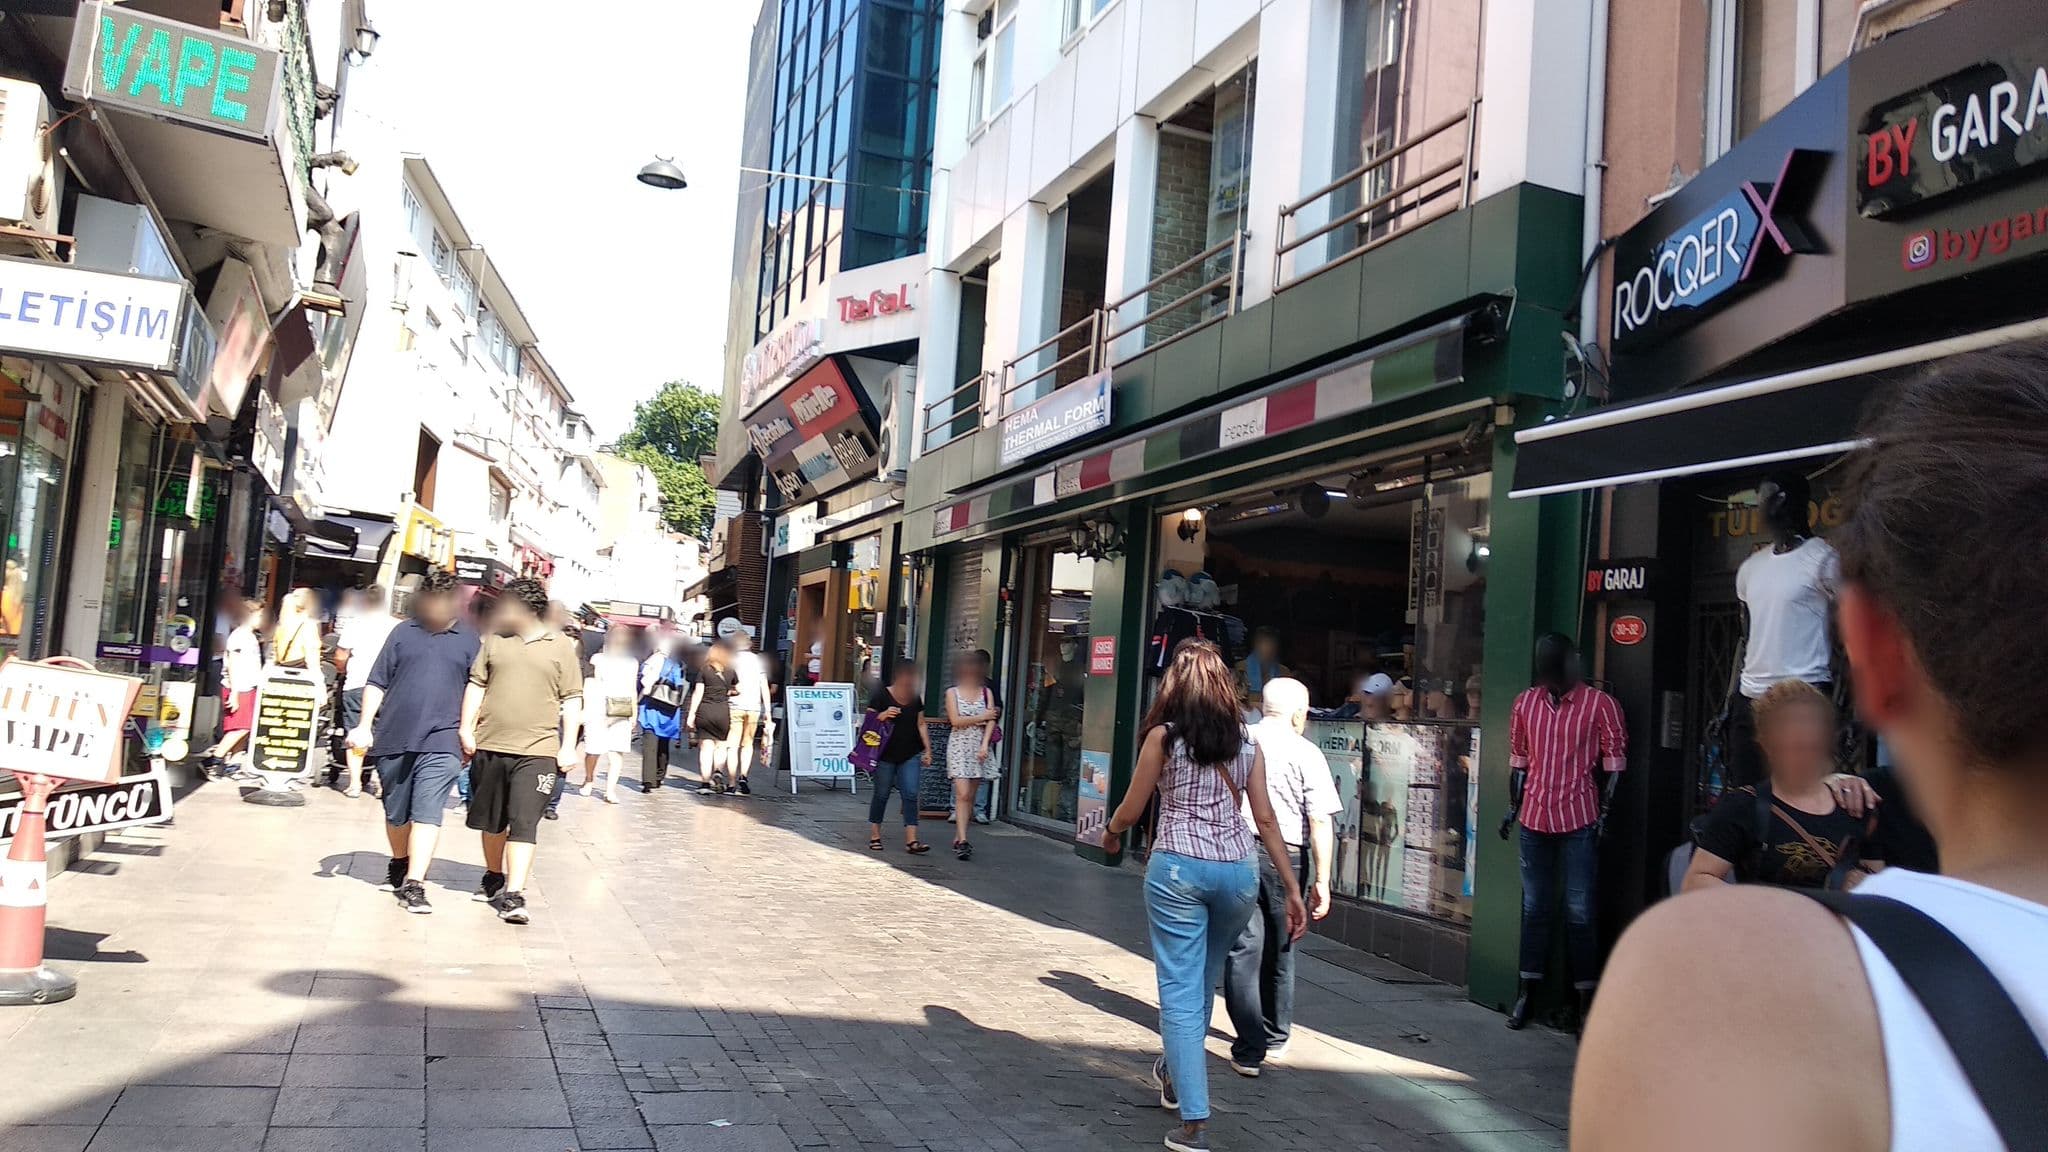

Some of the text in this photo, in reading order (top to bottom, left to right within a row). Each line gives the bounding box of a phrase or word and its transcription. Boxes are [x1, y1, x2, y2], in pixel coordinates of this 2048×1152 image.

[101, 15, 257, 123] VAPE
[1867, 116, 1918, 187] BY
[836, 283, 914, 323] Tefal
[790, 384, 838, 426] Miele
[1004, 416, 1061, 450] THERMAL
[1064, 395, 1105, 425] FORM
[1005, 408, 1038, 433] HEMA
[833, 433, 871, 470] BRAUN
[1587, 567, 1645, 592] BY GARAJ
[793, 689, 844, 700] SIEMENS
[7, 719, 96, 759] VAPE
[814, 757, 849, 773] 7900
